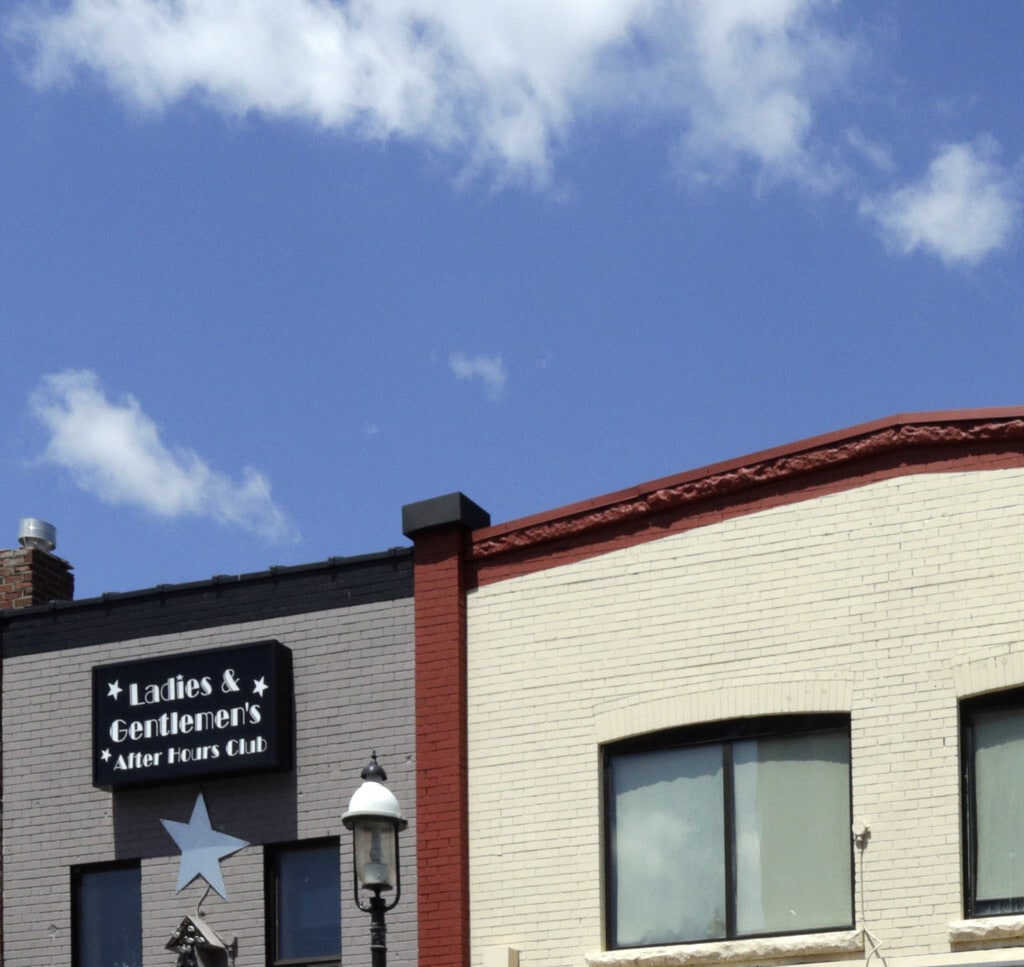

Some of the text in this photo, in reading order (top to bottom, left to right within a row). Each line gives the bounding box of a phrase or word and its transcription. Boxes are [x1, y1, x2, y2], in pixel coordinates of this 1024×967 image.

[129, 669, 240, 706] Ladies &
[109, 702, 262, 743] Gentlemen's
[113, 736, 268, 771] After Hours Club
